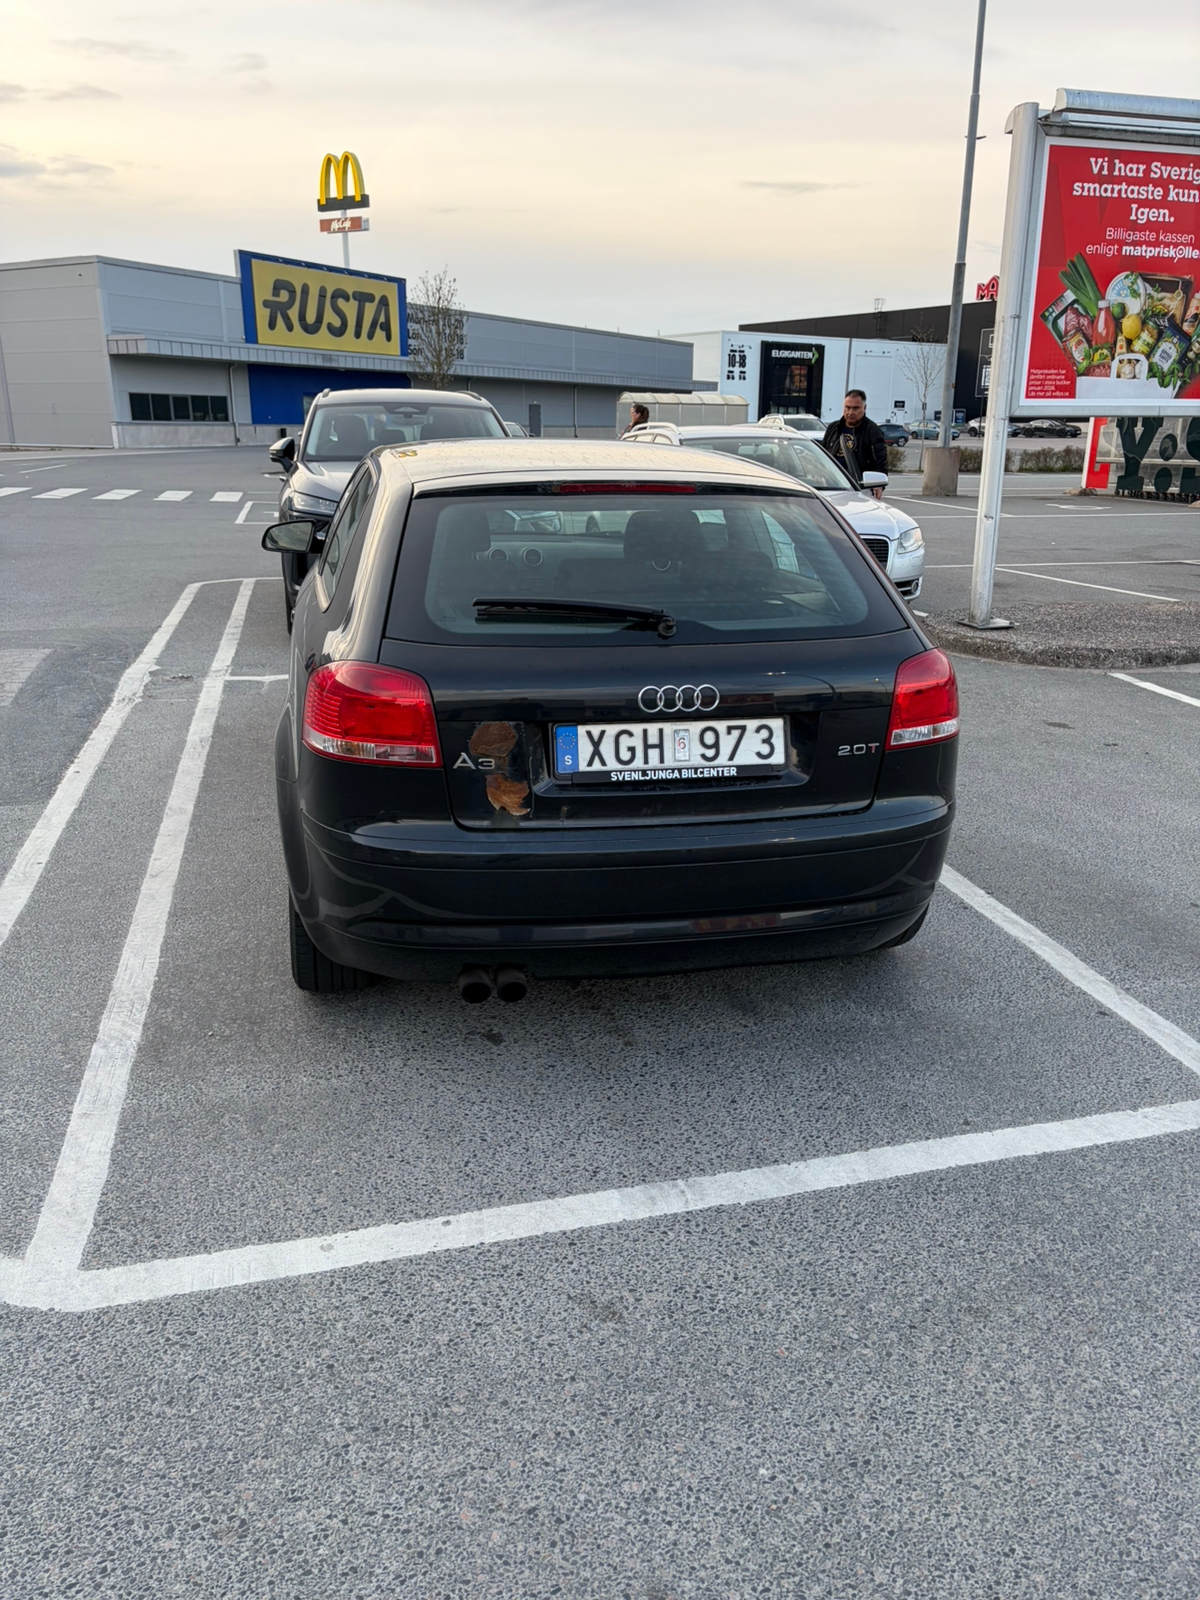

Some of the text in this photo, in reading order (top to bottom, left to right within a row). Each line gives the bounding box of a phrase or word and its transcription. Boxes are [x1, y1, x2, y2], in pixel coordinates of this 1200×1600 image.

[1089, 157, 1108, 176] Vi
[1113, 159, 1146, 177] har
[1072, 181, 1200, 203] smartaste kun
[1129, 203, 1175, 224] Igen.
[1105, 227, 1195, 244] Billigaste kassen
[1085, 243, 1200, 263] enligt matpriskolle
[262, 278, 392, 343] RUSTA
[727, 353, 747, 368] 10-18
[771, 349, 813, 359] ELGIGANTEN
[564, 723, 775, 767] S XGH 973
[678, 737, 687, 750] 6
[452, 751, 496, 770] A3
[610, 767, 737, 781] SVENLJUNGA BILCENTER
